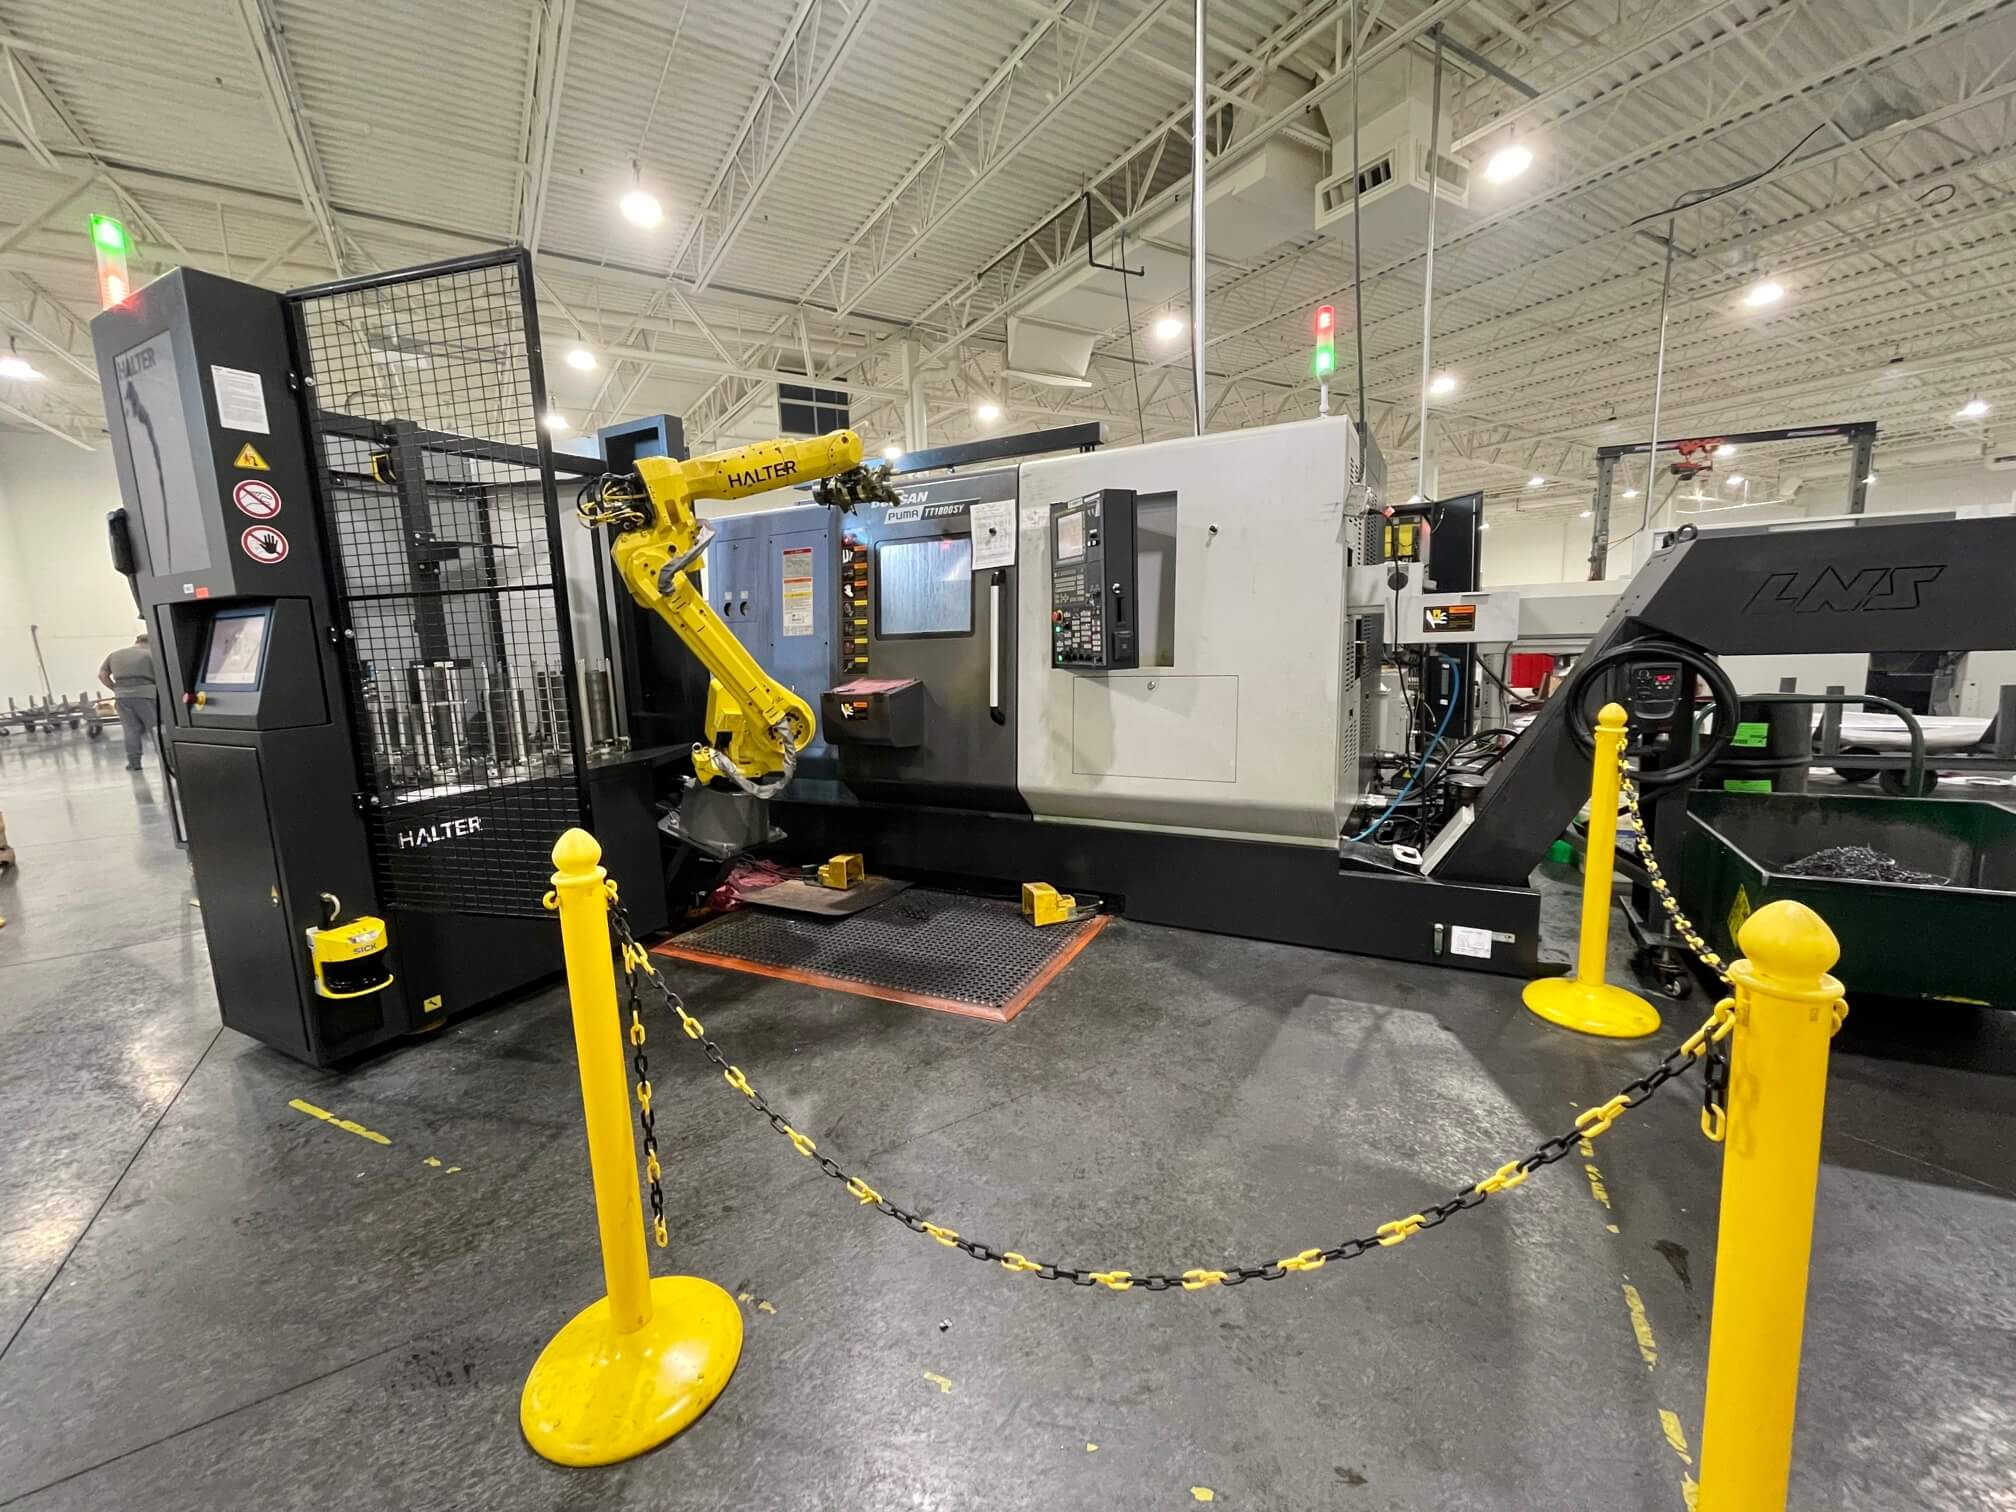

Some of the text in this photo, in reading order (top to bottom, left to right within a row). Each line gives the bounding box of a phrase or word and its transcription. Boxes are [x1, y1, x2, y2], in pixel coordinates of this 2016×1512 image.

[117, 347, 156, 381] HALTER
[728, 460, 797, 488] HALTER
[888, 509, 919, 521] PUMA
[1740, 565, 1948, 614] LNS
[398, 815, 483, 849] HALTER
[353, 943, 377, 955] SICK
